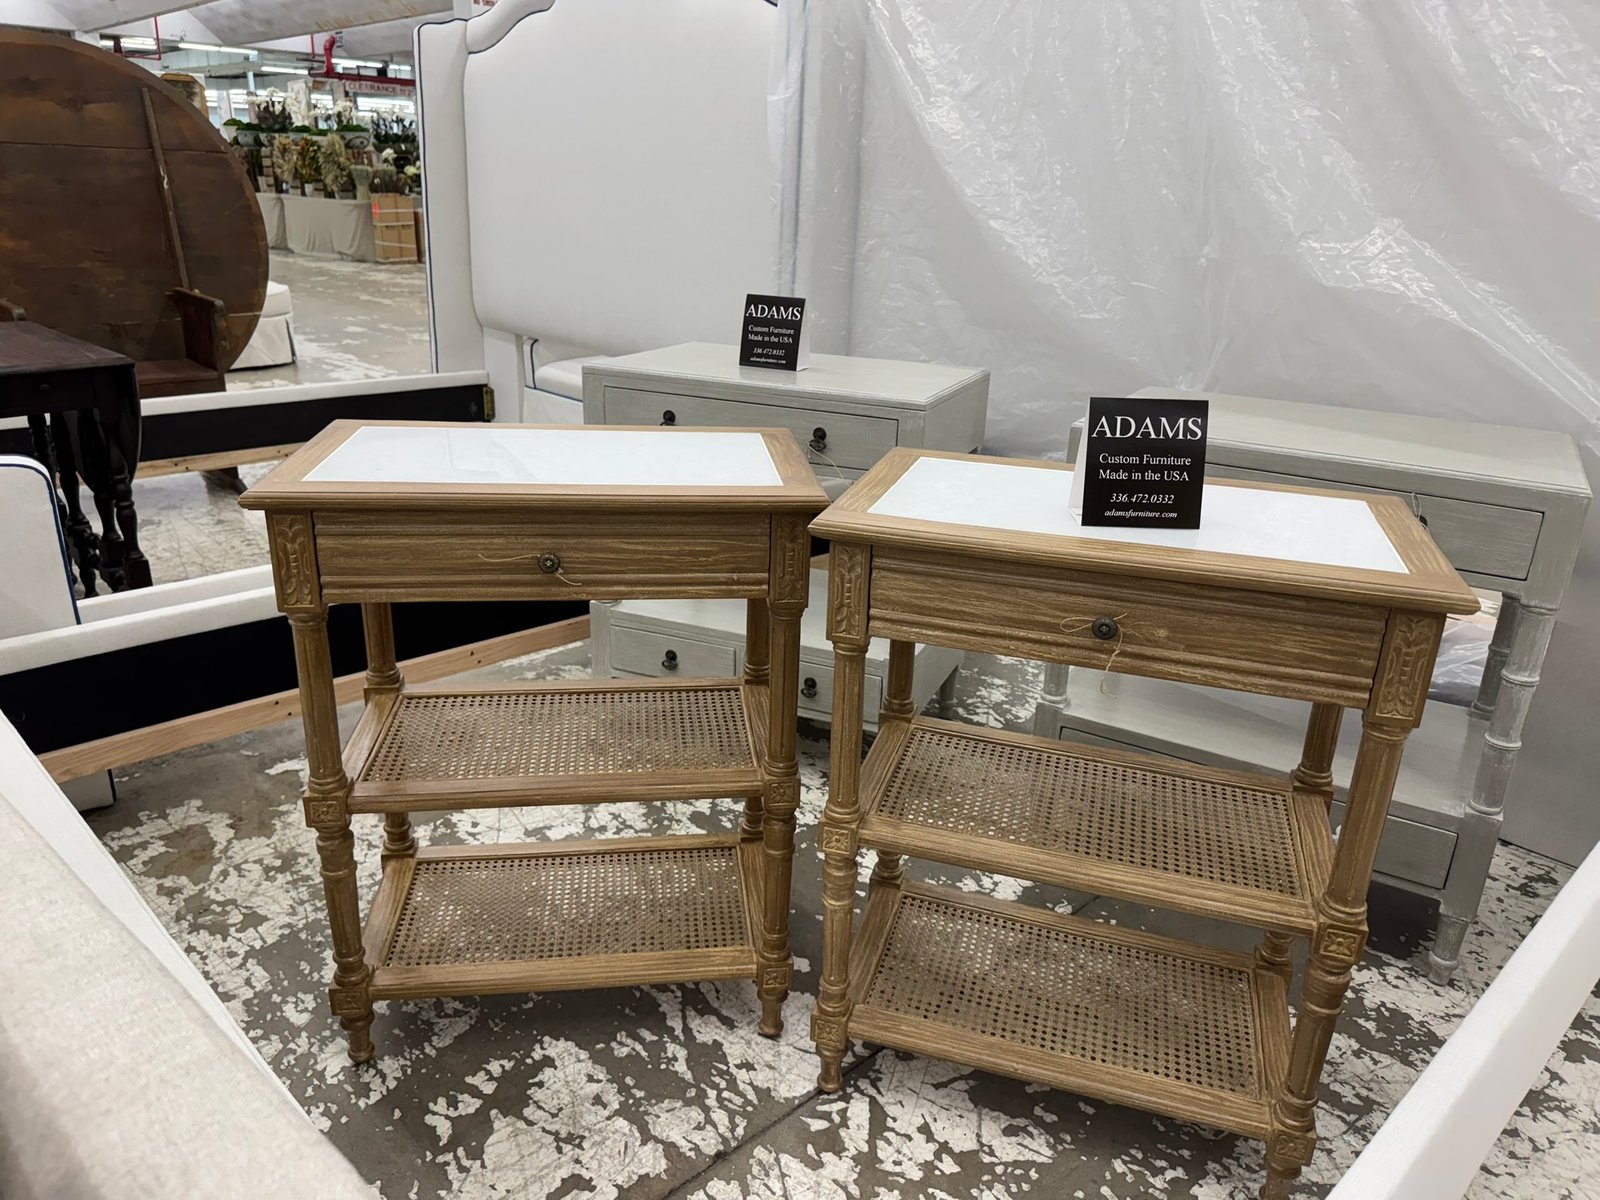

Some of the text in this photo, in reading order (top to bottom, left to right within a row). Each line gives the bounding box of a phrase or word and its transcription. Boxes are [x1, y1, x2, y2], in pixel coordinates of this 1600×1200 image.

[746, 304, 801, 321] ADAMS
[748, 324, 795, 335] Custom Furniture
[748, 333, 763, 341] Made
[779, 336, 793, 344] USA
[1091, 415, 1202, 440] ADAMS
[1099, 453, 1192, 466] Custom Furniture
[1098, 469, 1189, 482] Made in the USA
[1110, 493, 1175, 504] 336.472.0332
[1104, 508, 1178, 519] adamsfurniture.com
